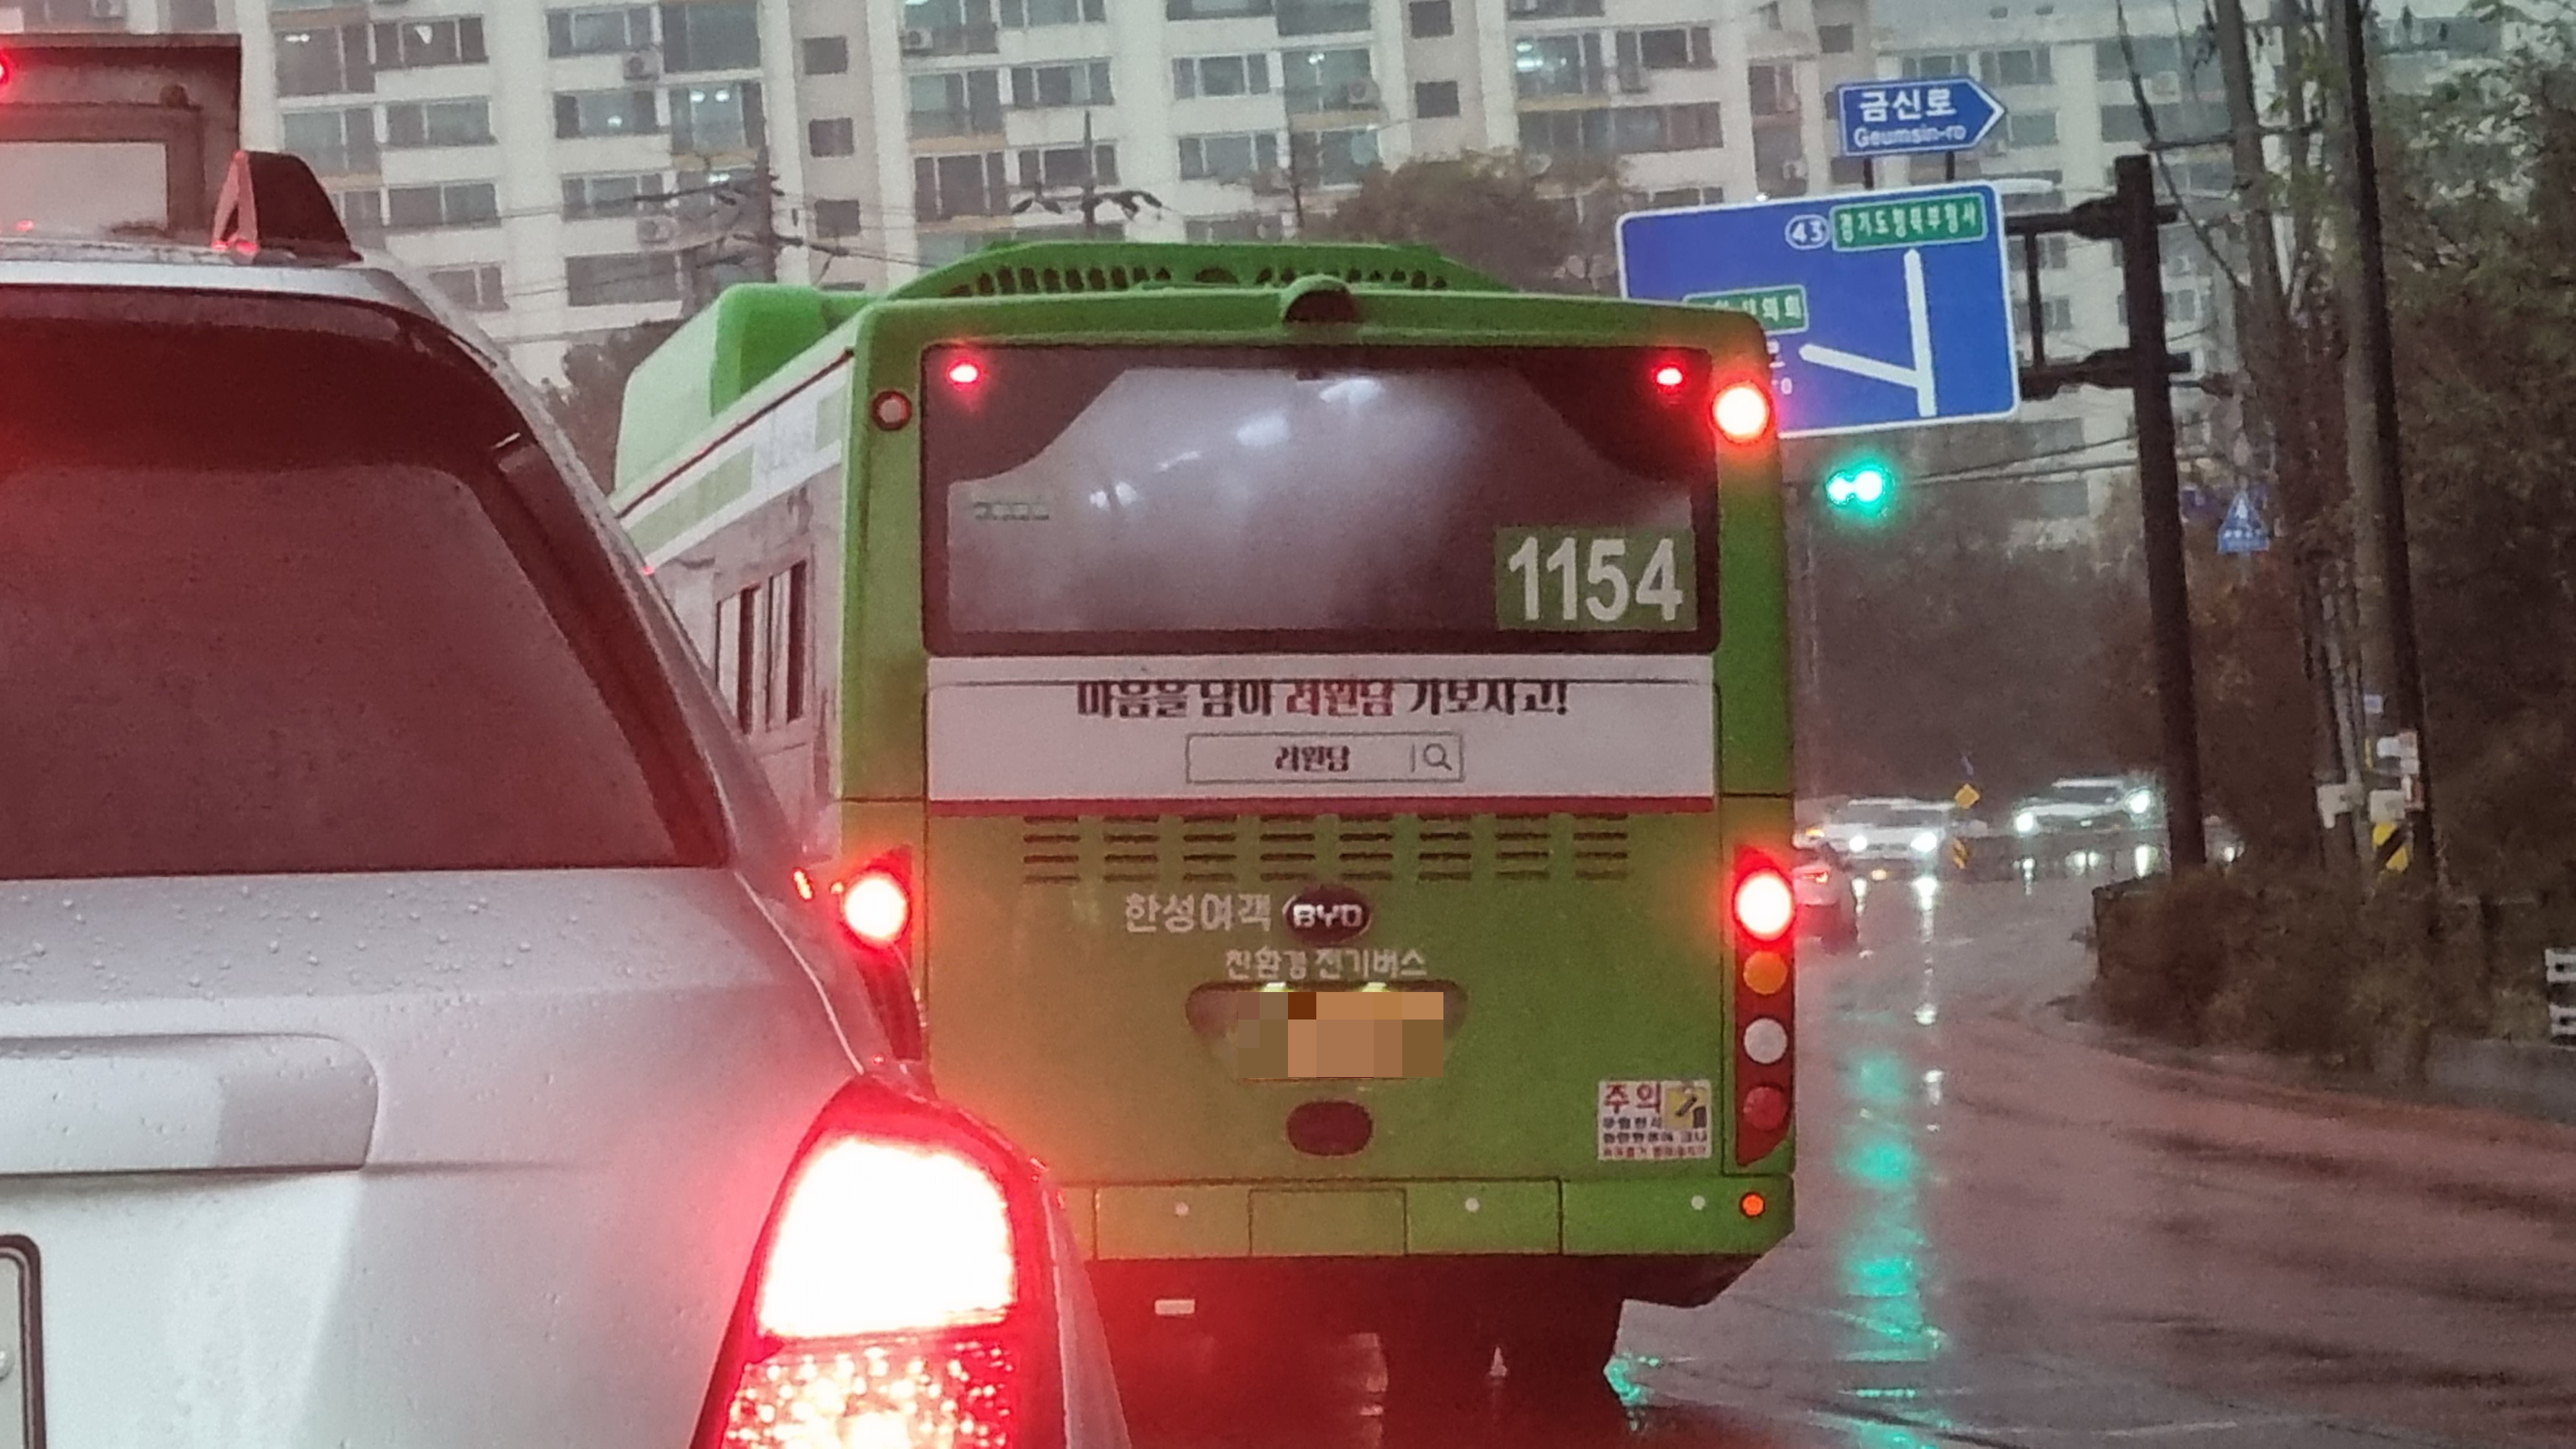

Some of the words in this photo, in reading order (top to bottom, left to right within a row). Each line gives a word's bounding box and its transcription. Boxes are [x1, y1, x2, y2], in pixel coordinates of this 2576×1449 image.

[1859, 88, 1957, 122] 금신로
[1853, 125, 1967, 148] Geumsin-ro
[1792, 220, 1824, 242] 43
[1508, 536, 1684, 622] 1154
[1078, 679, 1187, 718] 마음을
[1200, 679, 1271, 717] 담아
[1125, 892, 1272, 934] 한성여객
[1291, 903, 1364, 928] BYD
[1225, 947, 1309, 981] 친환경
[1315, 947, 1428, 981] 전기버스
[1604, 1083, 1661, 1114] 주의
